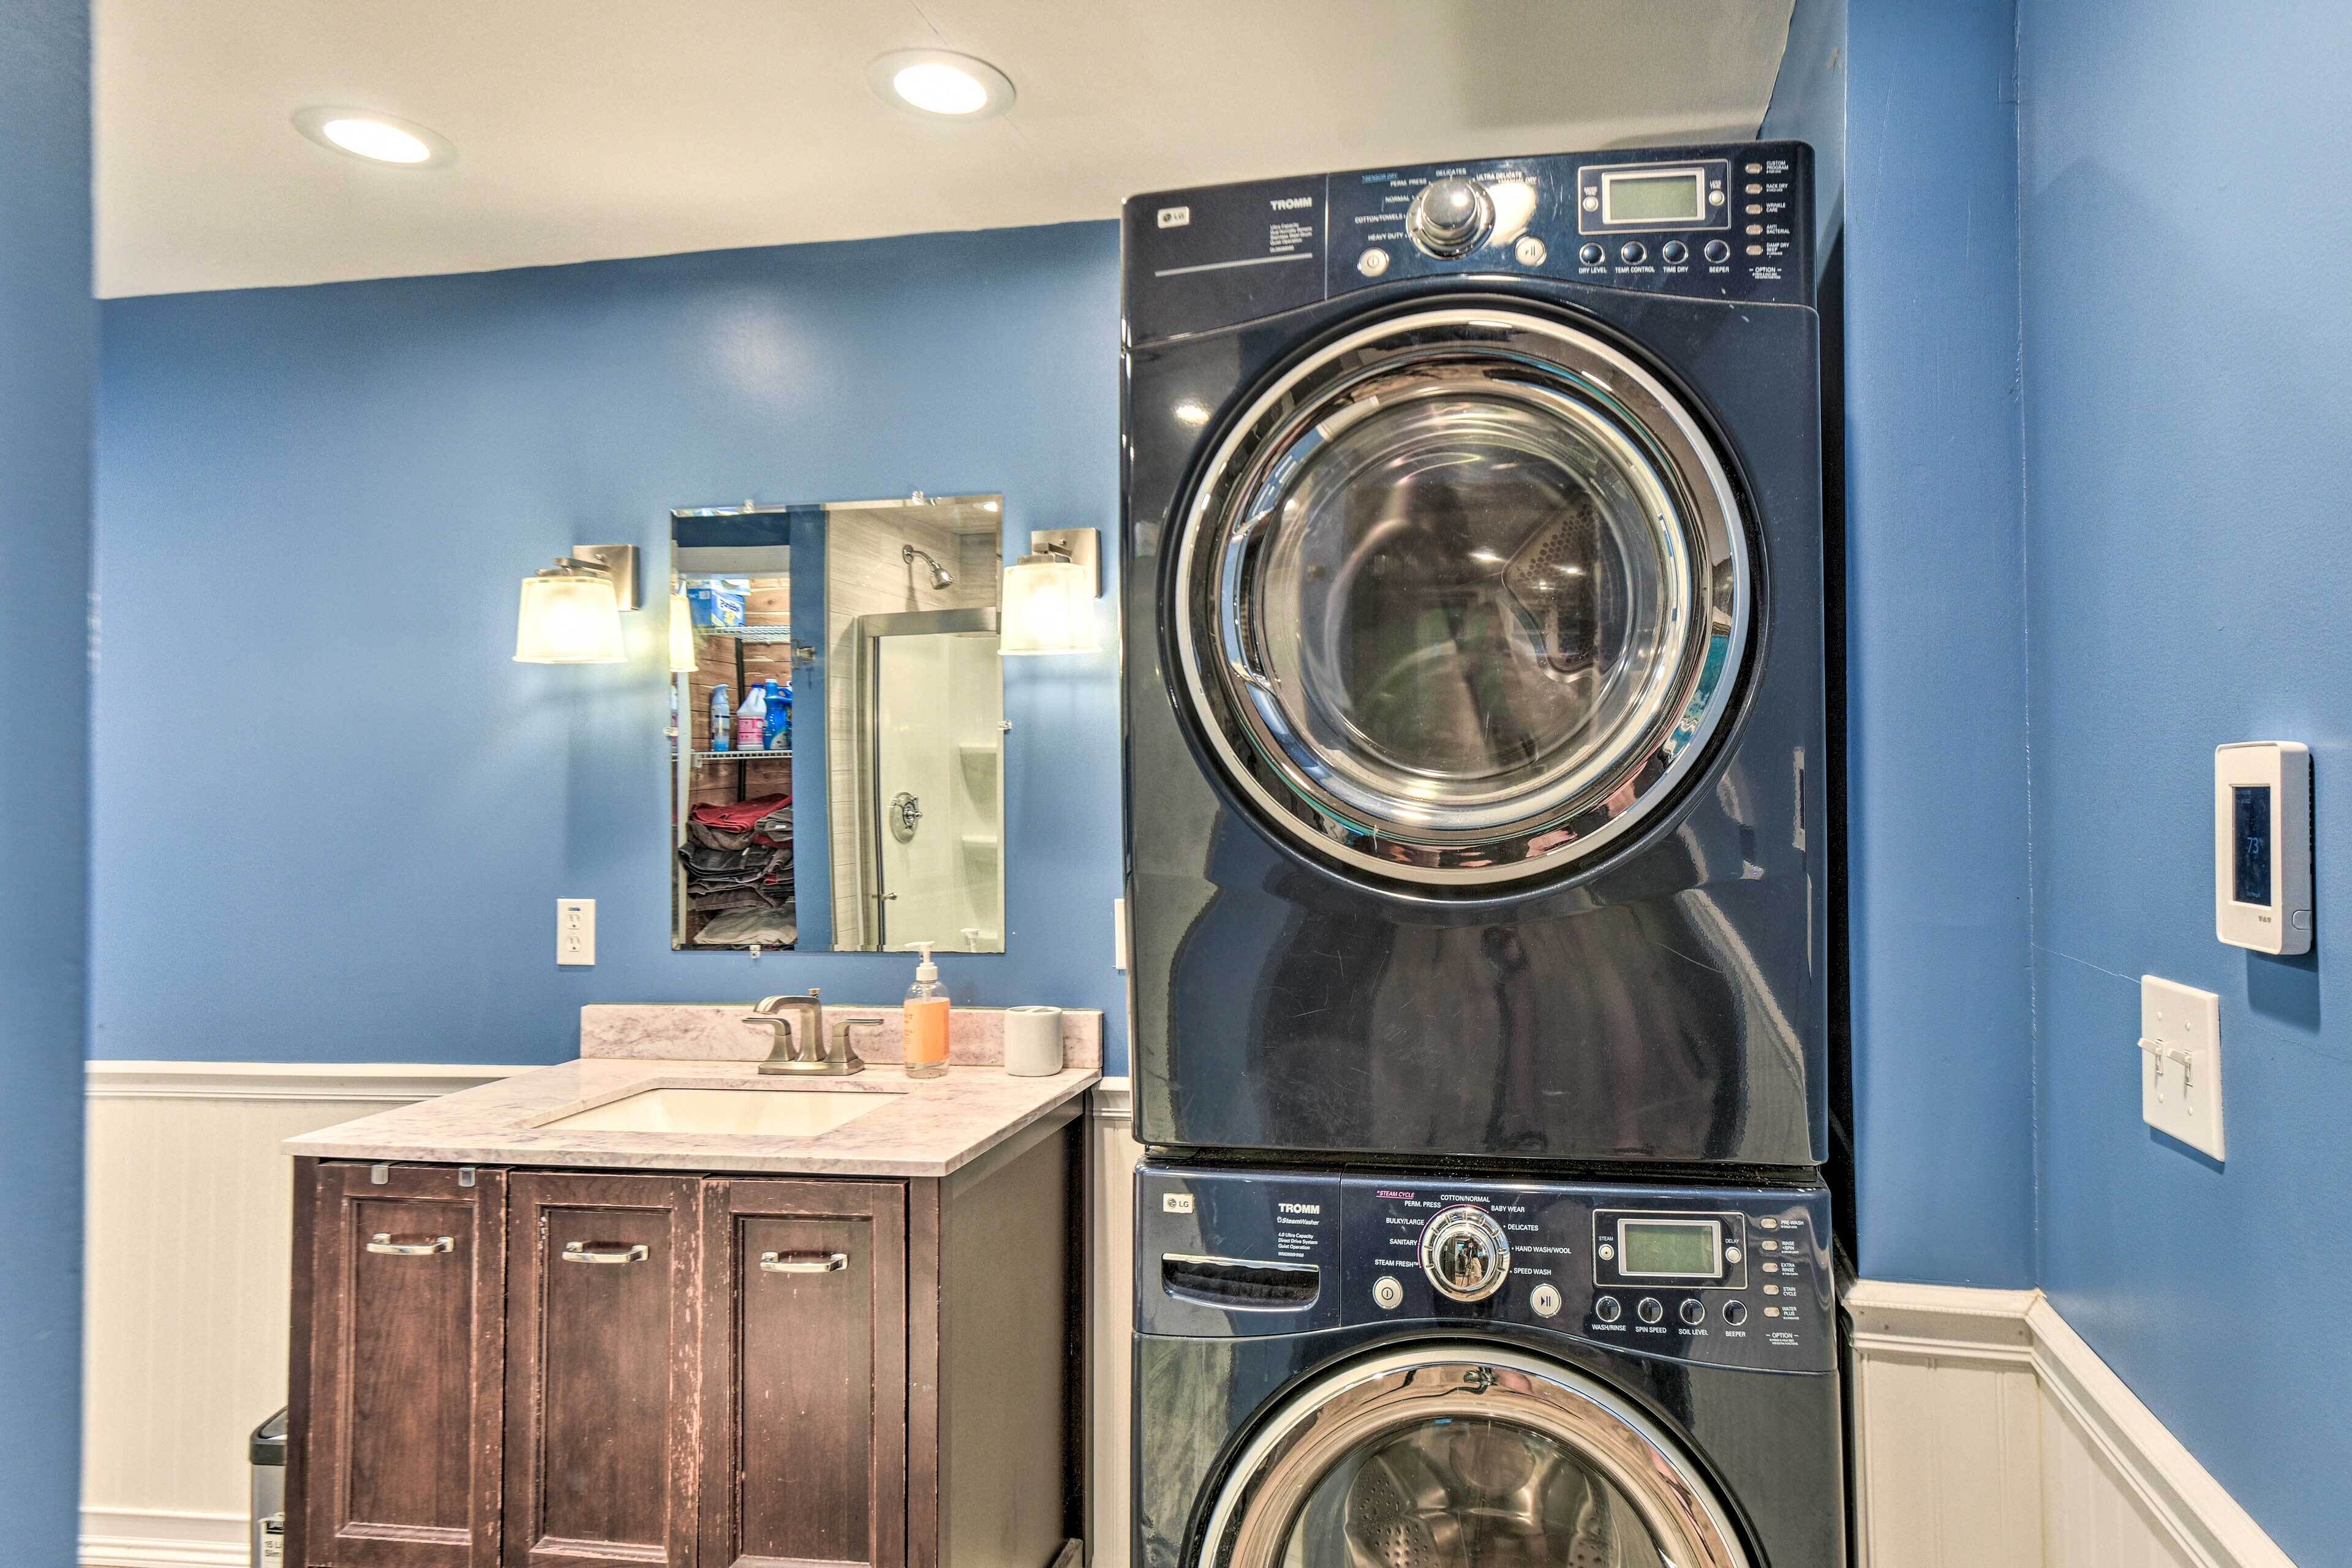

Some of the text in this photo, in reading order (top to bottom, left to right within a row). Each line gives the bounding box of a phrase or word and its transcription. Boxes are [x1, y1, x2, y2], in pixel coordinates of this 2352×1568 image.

[1436, 168, 1466, 177] DELICATES
[1476, 173, 1494, 181] ULTRA
[1270, 197, 1312, 211] TROMM
[1278, 1203, 1320, 1214] TROMM
